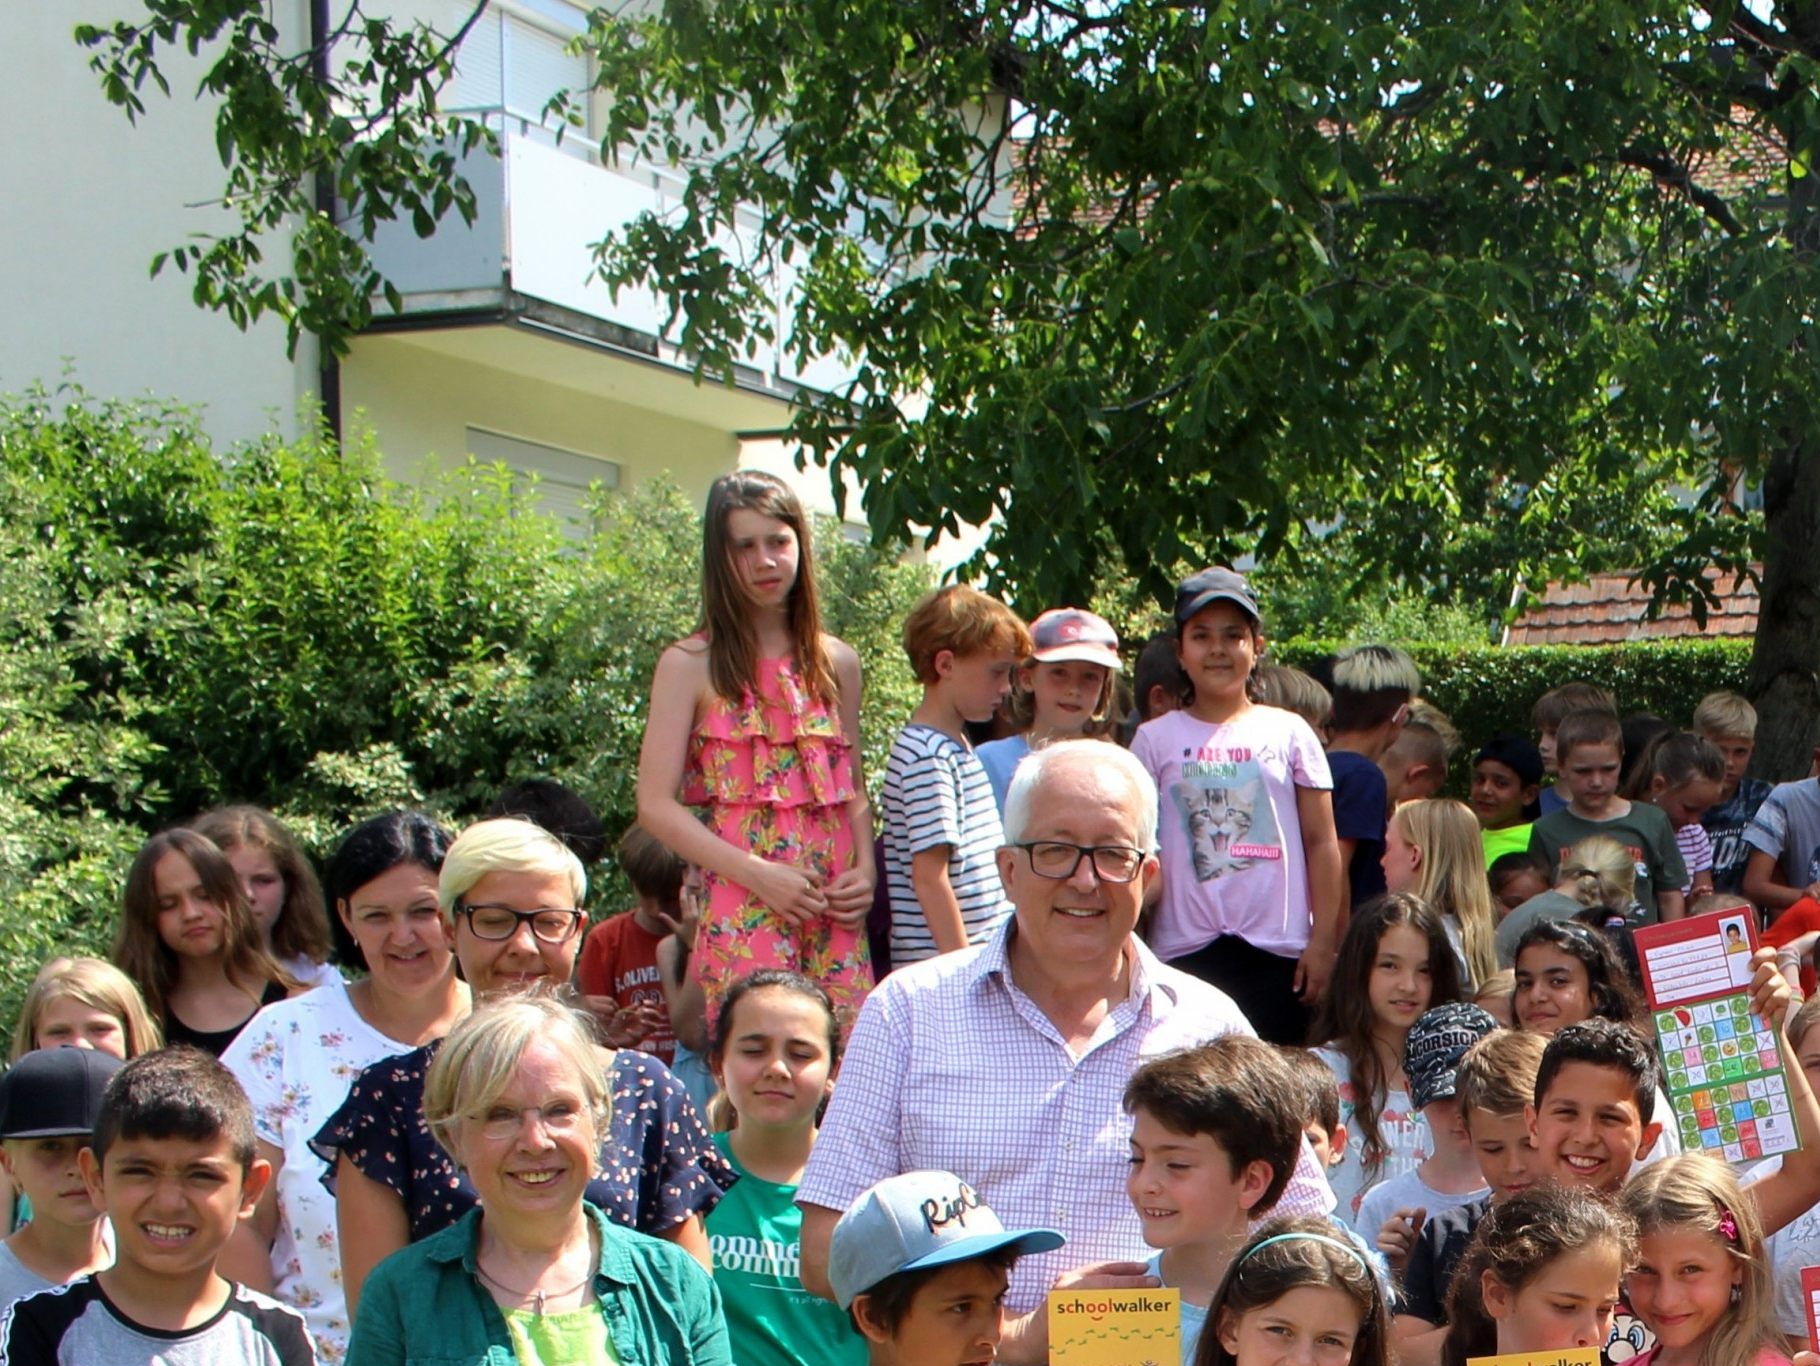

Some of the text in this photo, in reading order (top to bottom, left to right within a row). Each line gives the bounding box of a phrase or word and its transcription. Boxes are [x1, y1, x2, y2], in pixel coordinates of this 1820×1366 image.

[1197, 748, 1221, 761] ARE
[1228, 748, 1252, 762] YOU
[1415, 1030, 1479, 1057] CORSICA
[1380, 1120, 1425, 1149] WER
[1057, 1298, 1171, 1313] schoolwalker
